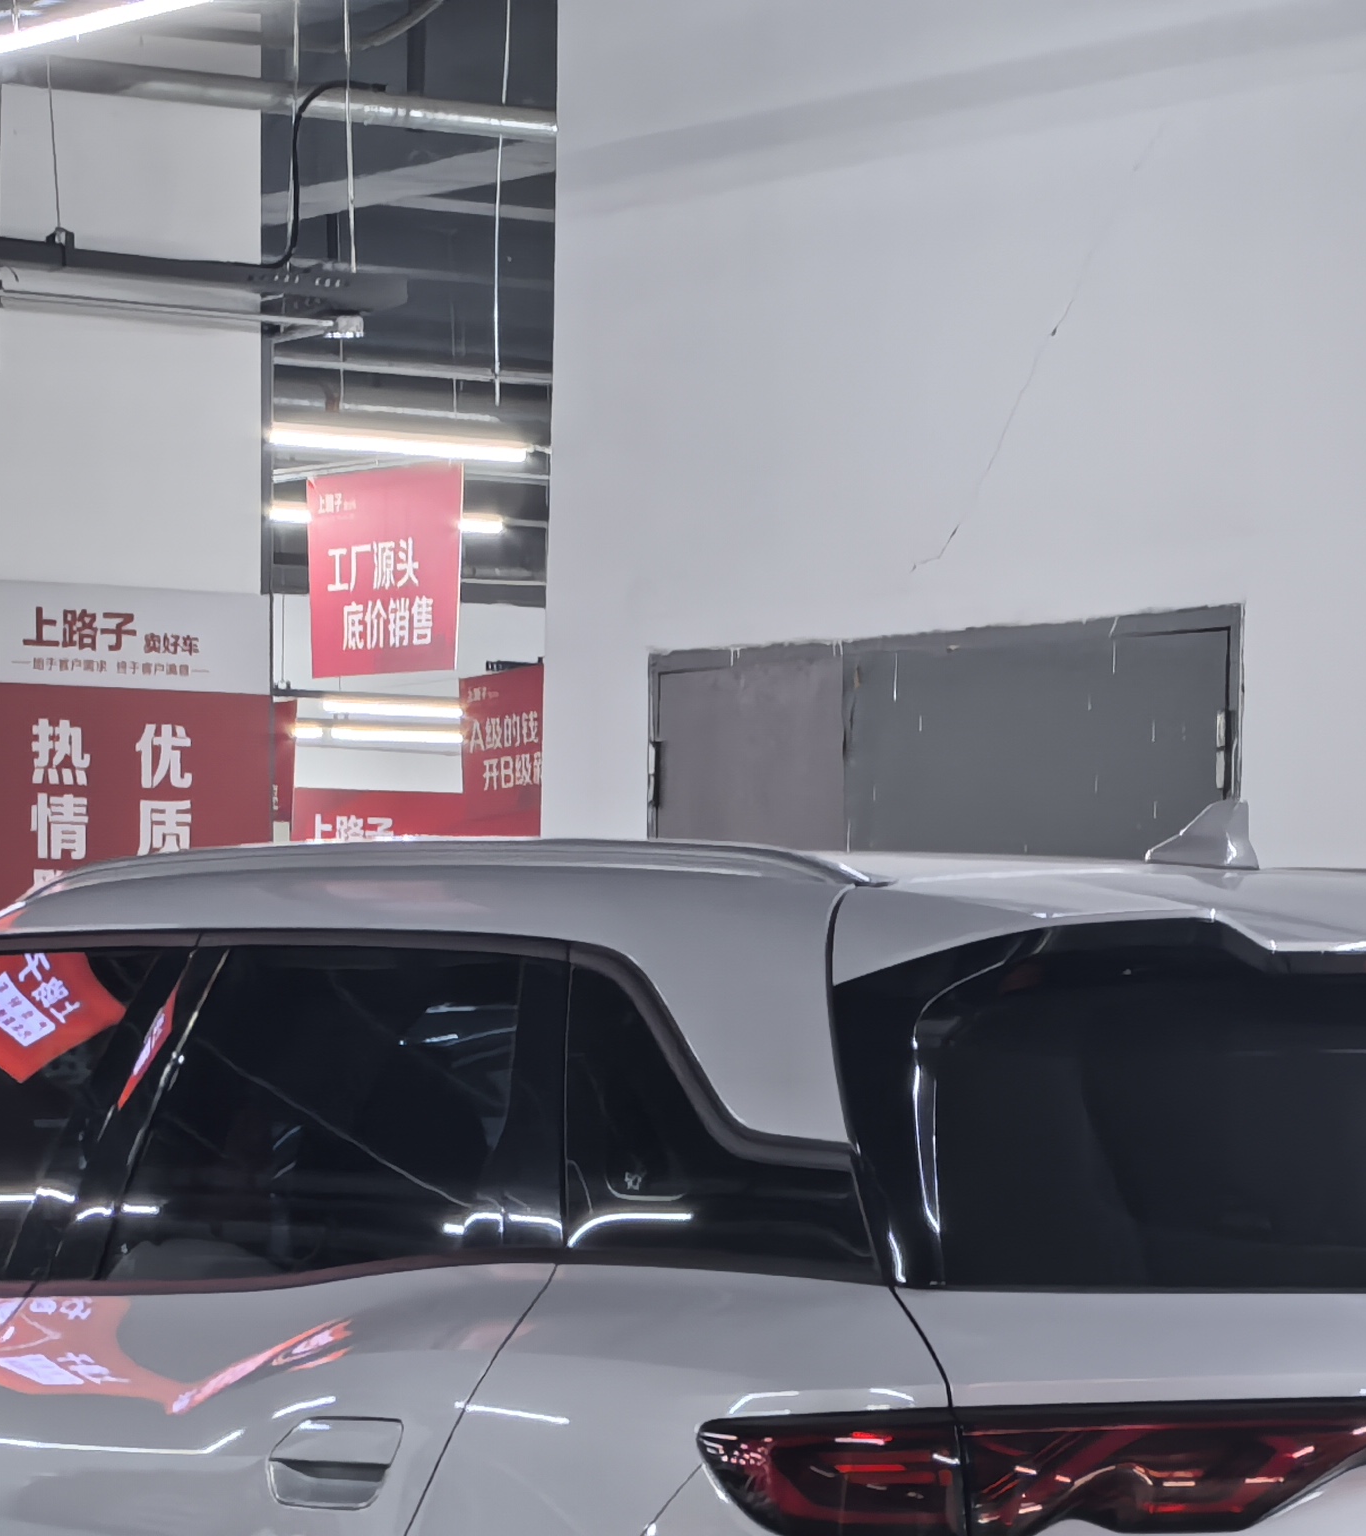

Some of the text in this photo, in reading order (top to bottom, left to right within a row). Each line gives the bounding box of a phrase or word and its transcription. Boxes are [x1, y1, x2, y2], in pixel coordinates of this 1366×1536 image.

[327, 537, 420, 593] 工厂源头
[23, 606, 137, 652] 上路子
[342, 595, 434, 651] 底价销售
[30, 718, 91, 886] 热情
[136, 723, 192, 857] 优质
